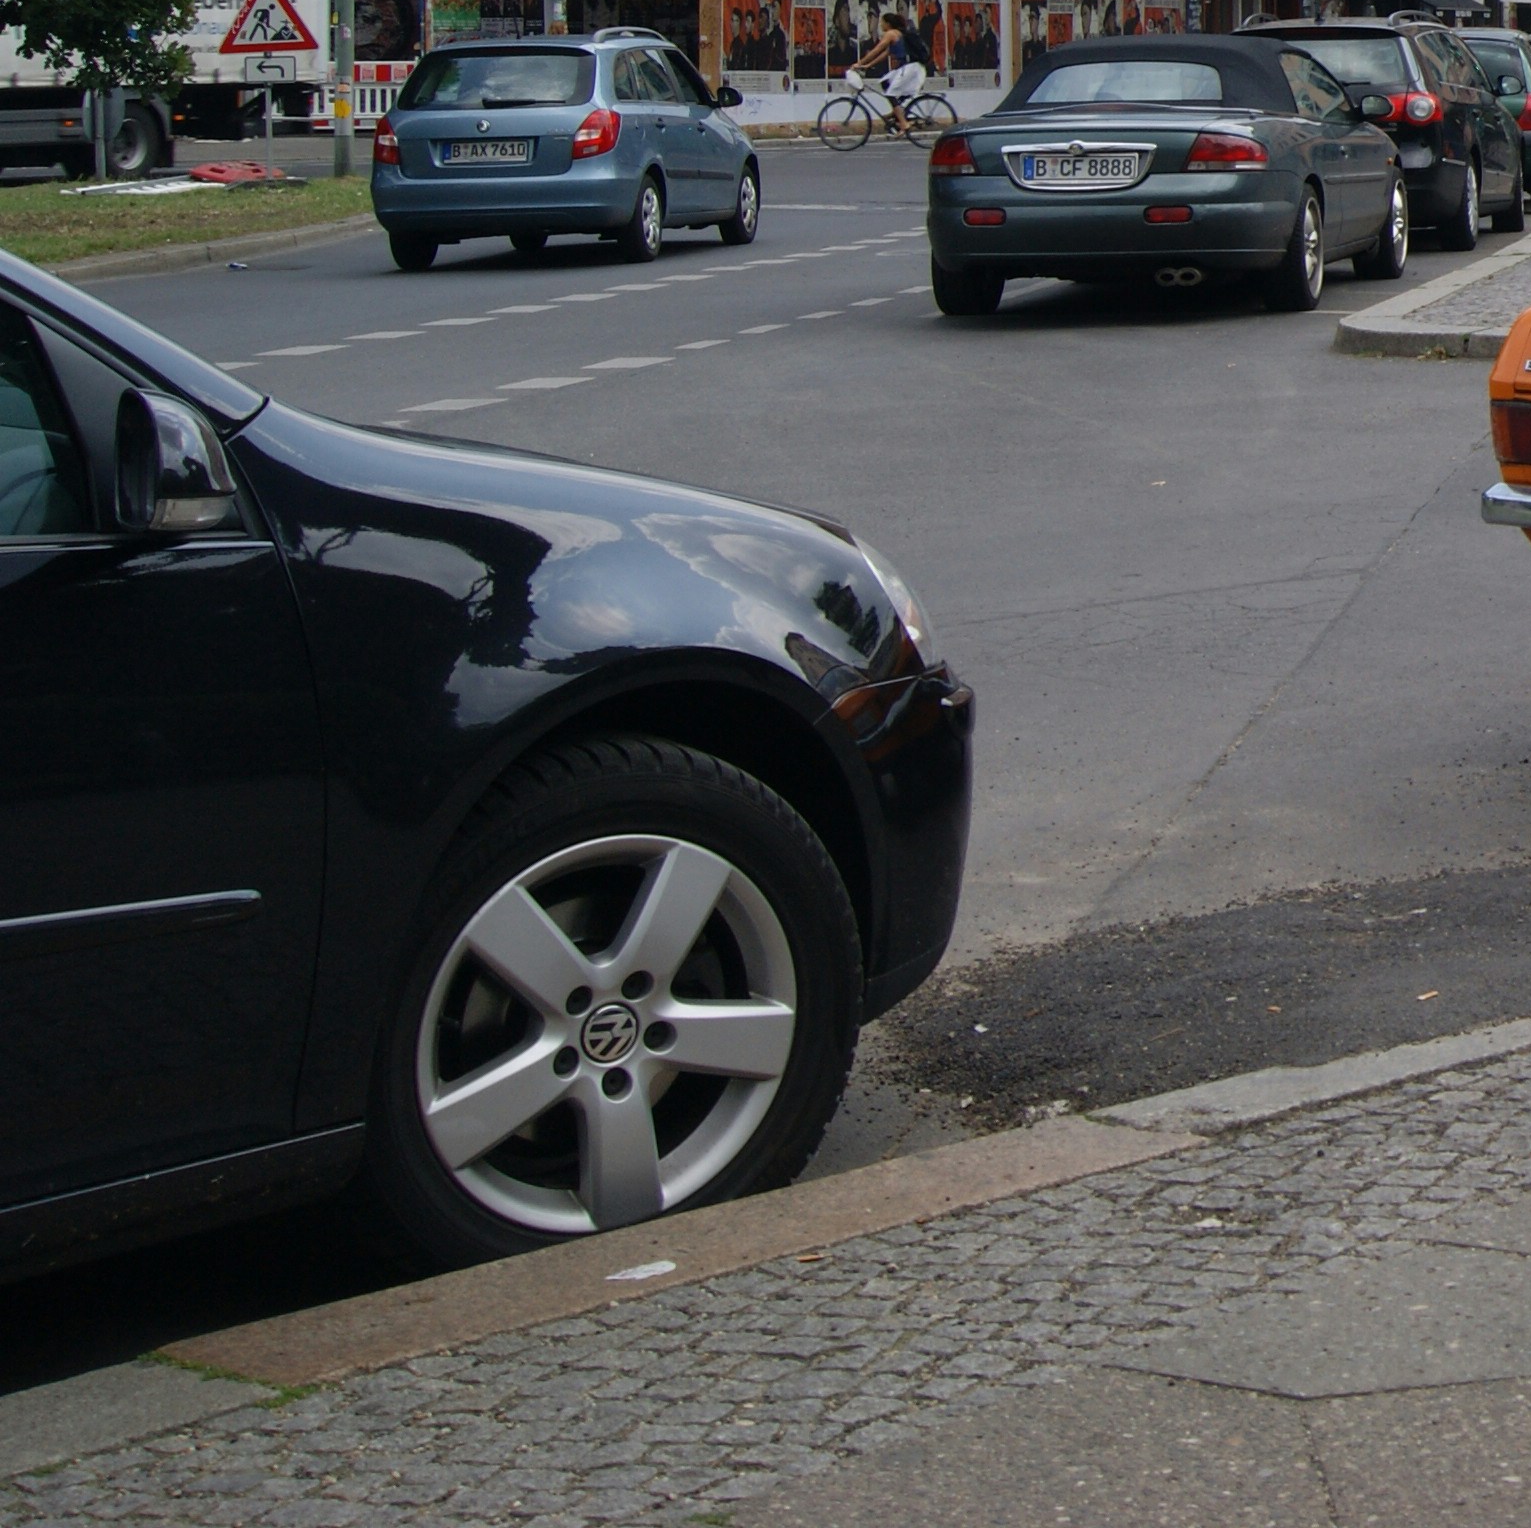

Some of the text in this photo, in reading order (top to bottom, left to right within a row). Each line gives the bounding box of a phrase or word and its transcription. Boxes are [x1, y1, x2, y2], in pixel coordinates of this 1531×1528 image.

[452, 143, 526, 158] B AX 7610
[1035, 159, 1133, 177] B CF 8888
